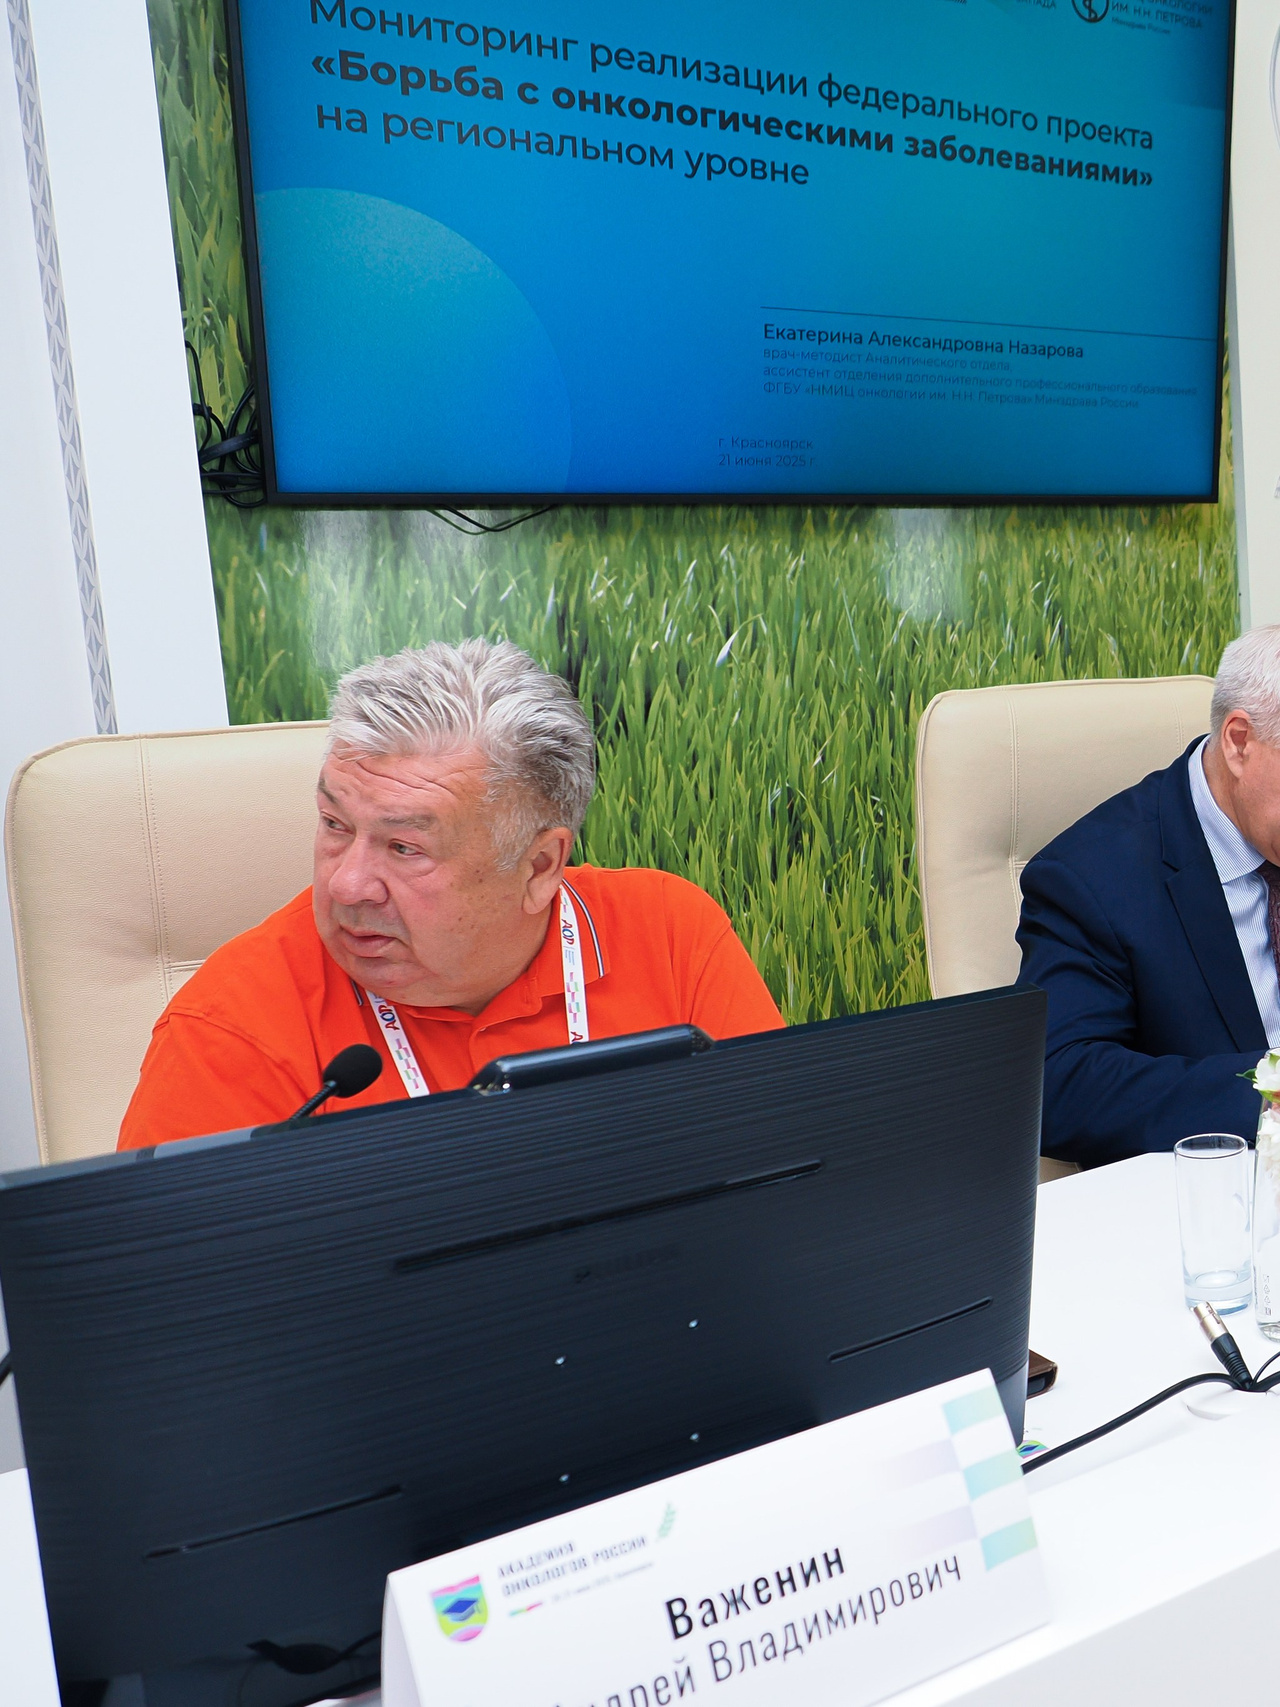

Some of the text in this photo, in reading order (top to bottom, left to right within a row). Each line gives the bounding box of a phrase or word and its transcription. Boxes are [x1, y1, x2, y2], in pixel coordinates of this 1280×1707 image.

[310, 0, 1153, 150] Мониторинг реализации федерального проекта
[311, 49, 1153, 187] «Борьба с онкологическими заболеваниями»
[316, 104, 810, 185] на региональном уровне
[763, 323, 1084, 359] Екатерина Александровна Назарова
[763, 348, 862, 364] врач-методист
[865, 352, 967, 370] Аналитического
[763, 366, 1198, 397] ассистент отделения дополнительного профессионального образования
[763, 381, 801, 395] ФГБУ
[804, 383, 855, 398] «НМИЦ
[857, 388, 926, 400] онкологии
[1035, 394, 1098, 408] Минздрава
[1100, 398, 1139, 409] России
[718, 454, 731, 467] 21
[735, 457, 772, 467] июня
[775, 455, 807, 468] 2025
[731, 436, 814, 452] Красноярск
[498, 1540, 575, 1578] АКАДЕМИЯ
[593, 1535, 647, 1565] РОССИИ
[665, 1547, 846, 1640] Важенин
[707, 1555, 962, 1682] Владимирович
